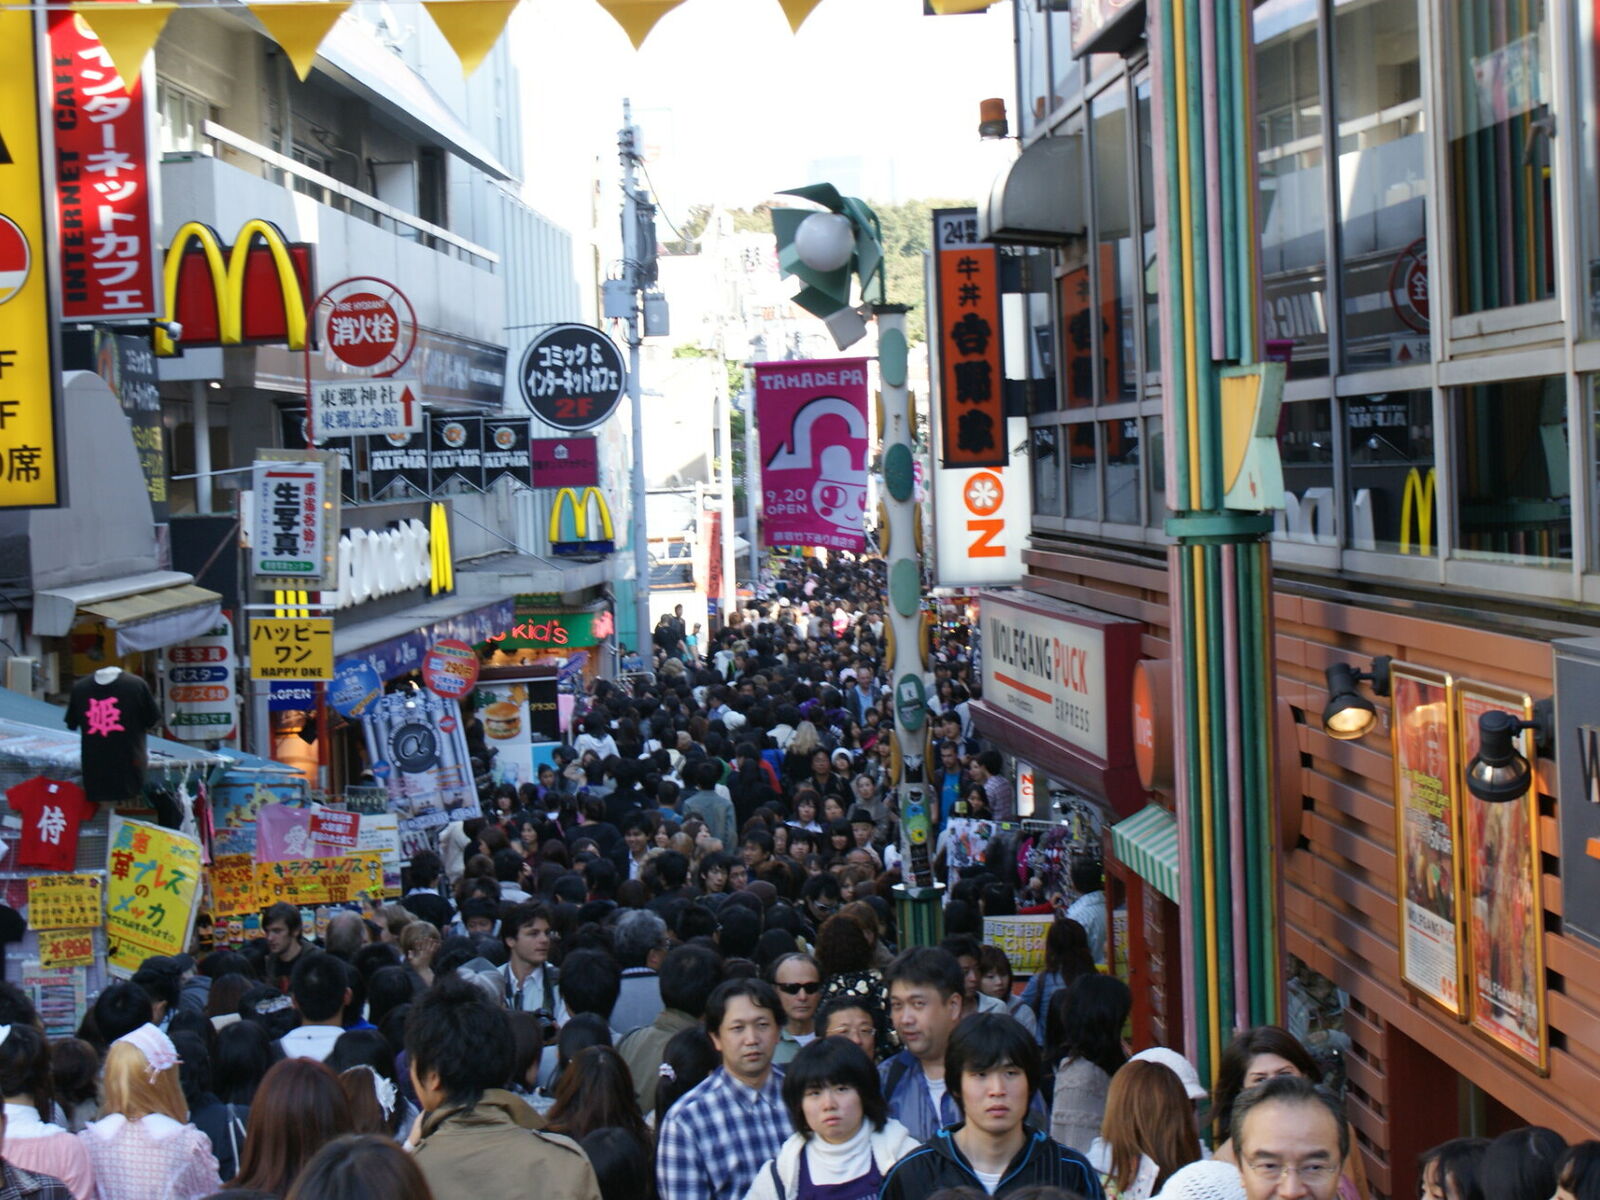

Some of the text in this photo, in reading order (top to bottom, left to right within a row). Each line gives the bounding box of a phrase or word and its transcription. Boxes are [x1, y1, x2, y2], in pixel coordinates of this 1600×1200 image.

[55, 53, 87, 302] INTERNET CAFE
[957, 256, 981, 307] 牛丼
[331, 312, 396, 347] 消火栓
[527, 366, 620, 397] インターネットカフェ
[320, 385, 398, 408] 東郷神社
[555, 398, 593, 418] 2F
[321, 407, 399, 430] 東郷記念館
[372, 455, 428, 470] ALPHA
[431, 455, 481, 469] ALPHA
[484, 456, 529, 469] ALPHA
[766, 488, 807, 503] 9.20
[272, 482, 300, 557] 生写真
[253, 622, 330, 641] ハッピー
[275, 645, 312, 663] ワン
[990, 617, 1088, 694] WOLFGANG PUCK
[261, 667, 323, 677] HAPPY ONE
[1055, 698, 1089, 733] EXPRESS
[37, 805, 67, 845] 侍
[135, 884, 149, 898] の
[112, 895, 166, 927] メッカ
